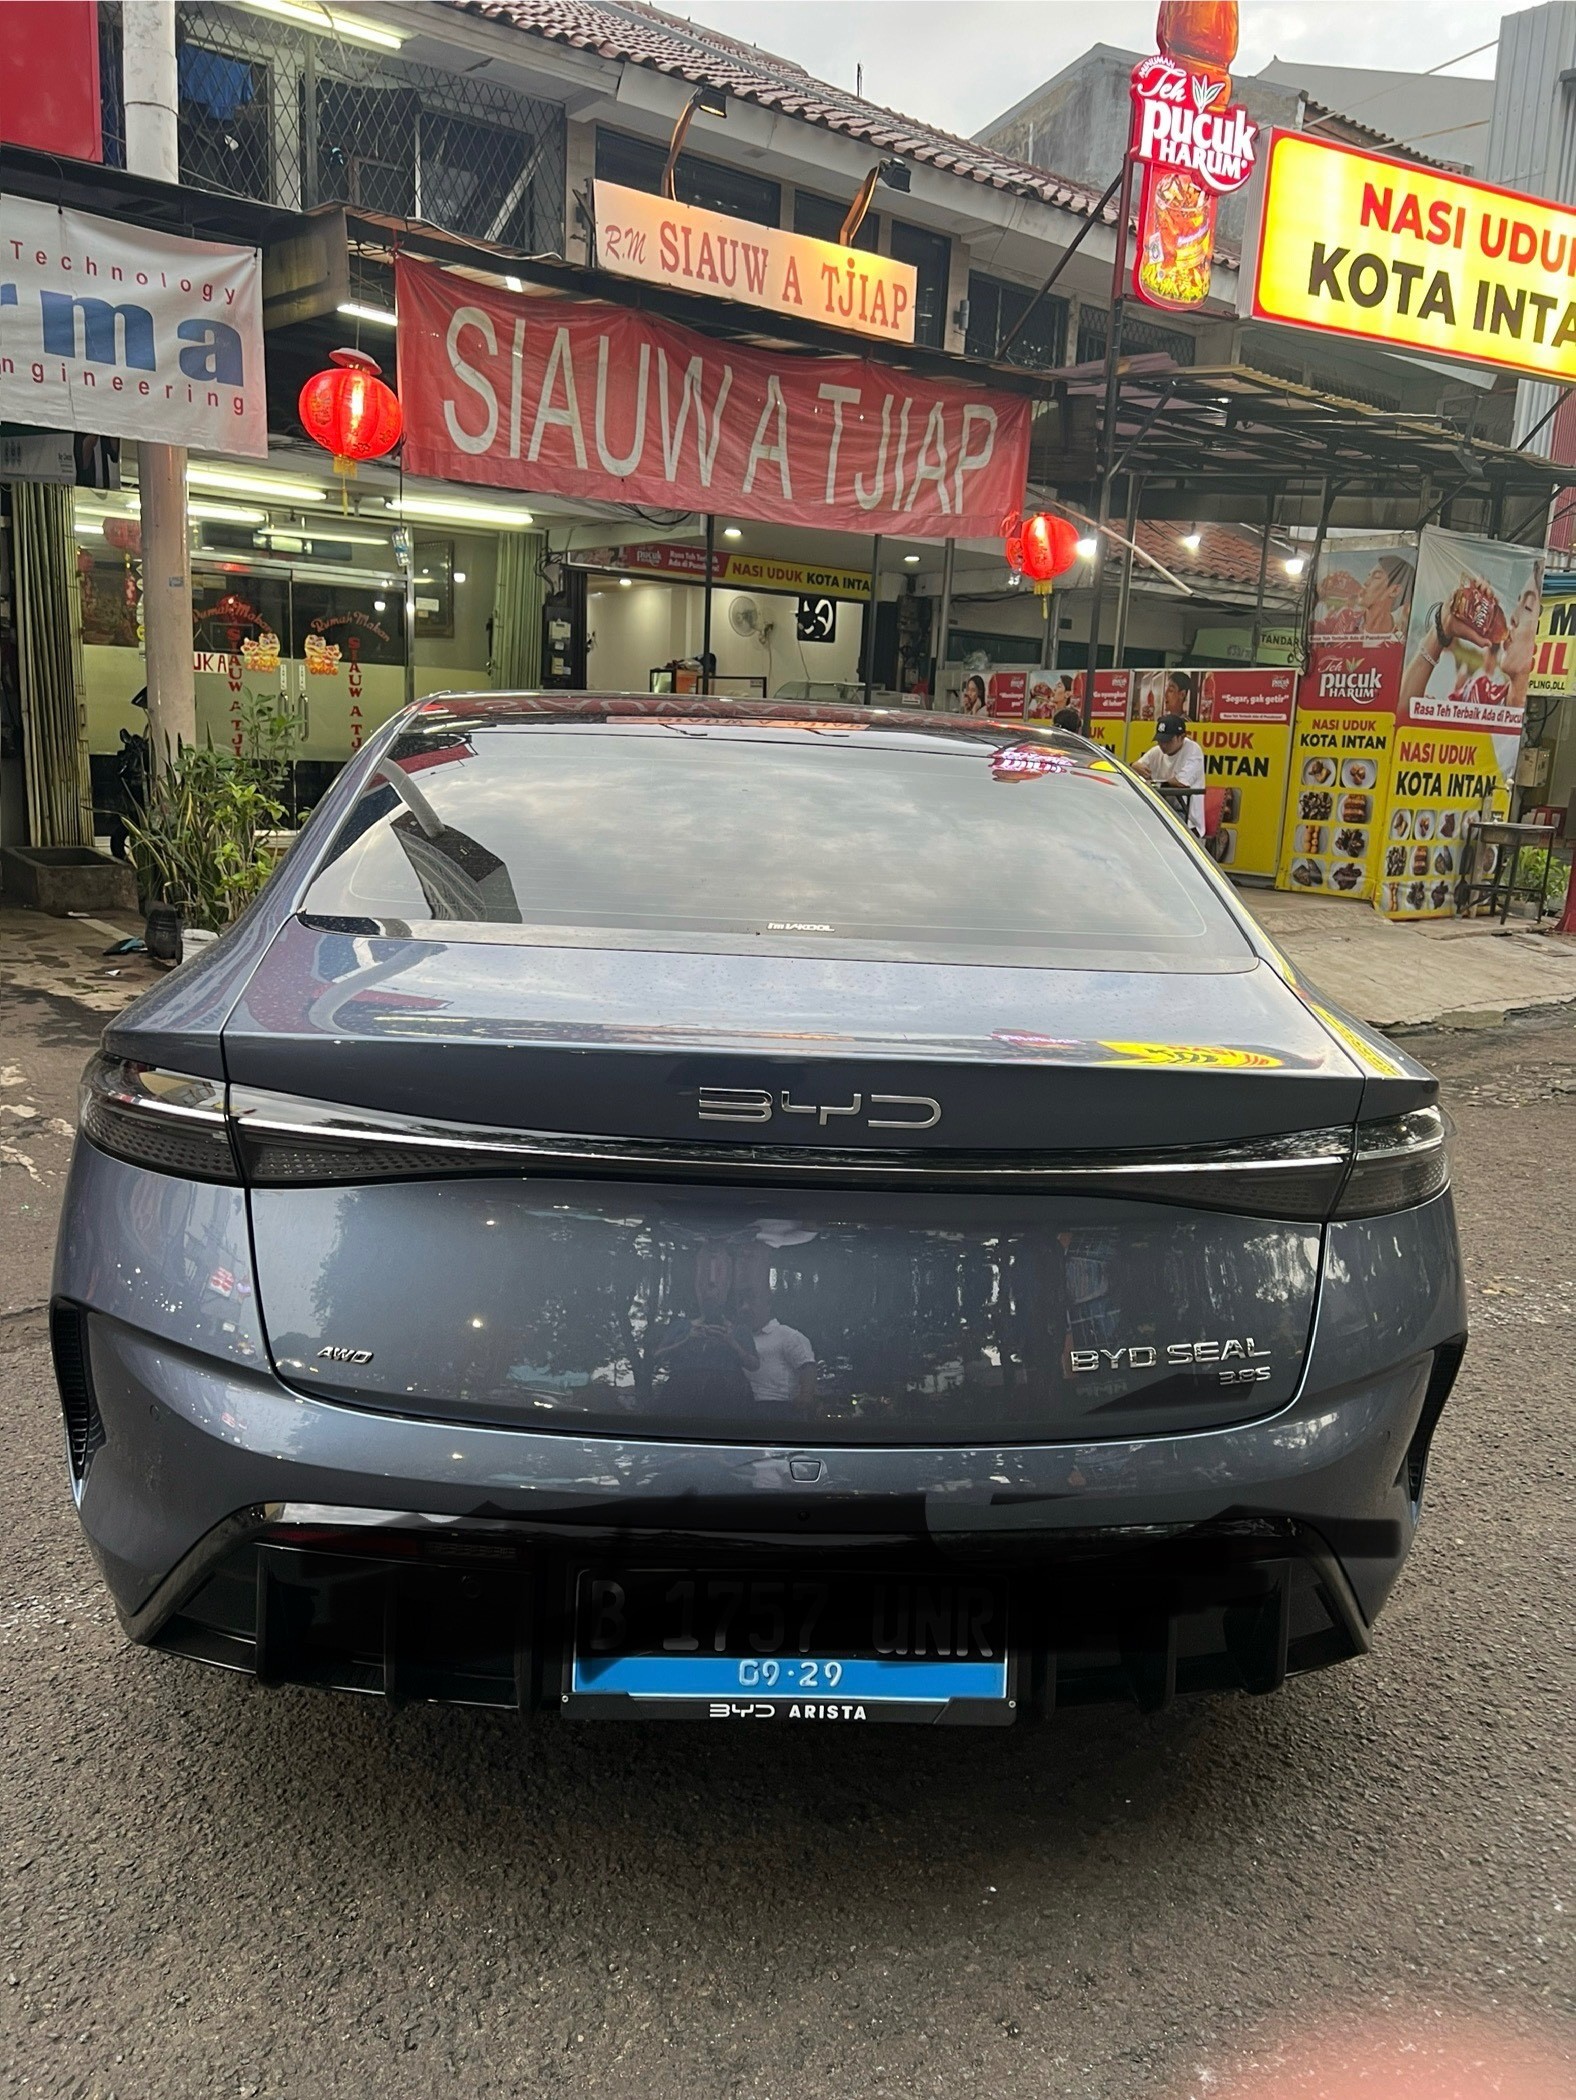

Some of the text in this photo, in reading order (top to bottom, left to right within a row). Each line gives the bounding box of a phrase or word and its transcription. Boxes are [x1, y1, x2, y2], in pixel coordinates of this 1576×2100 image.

[1139, 56, 1175, 78] MINUMAN
[1137, 64, 1187, 101] Teh
[1139, 99, 1256, 160] pucuk
[1159, 139, 1246, 184] HARUM
[1360, 182, 1576, 277] NASI UDU
[10, 240, 235, 305] Technology
[659, 221, 769, 296] SIAUW
[782, 256, 803, 305] A
[1308, 241, 1456, 326] KOTA
[444, 306, 998, 514] SIAUW A TJIAP
[733, 562, 763, 578] NASI
[767, 567, 803, 583] UDUK
[806, 572, 840, 588] KOTA
[843, 577, 872, 592] INTA
[353, 611, 390, 643] Makan
[1318, 655, 1344, 672] Teh
[1319, 667, 1382, 697] pucuk
[1329, 688, 1375, 702] HARUM
[350, 705, 363, 717] A
[1312, 719, 1376, 731] NASI UDUK
[1413, 702, 1434, 716] Rasa
[1436, 704, 1451, 717] Teh
[1453, 706, 1480, 720] Terbaik
[1481, 708, 1496, 721] Ada
[1497, 709, 1504, 722] di
[1202, 731, 1254, 749] UDUK
[1300, 733, 1386, 749] KOTA INTAN
[1399, 741, 1477, 766] NASI UDUK
[1203, 754, 1269, 778] INTAN
[1396, 771, 1496, 798] KOTA INTAN
[699, 1087, 942, 1129] BYD
[317, 1346, 374, 1364] AWD
[1070, 1338, 1272, 1372] BYD SEAL
[589, 1580, 994, 1658] B 1757 UNR
[709, 1703, 867, 1721] BYD ARISTA
